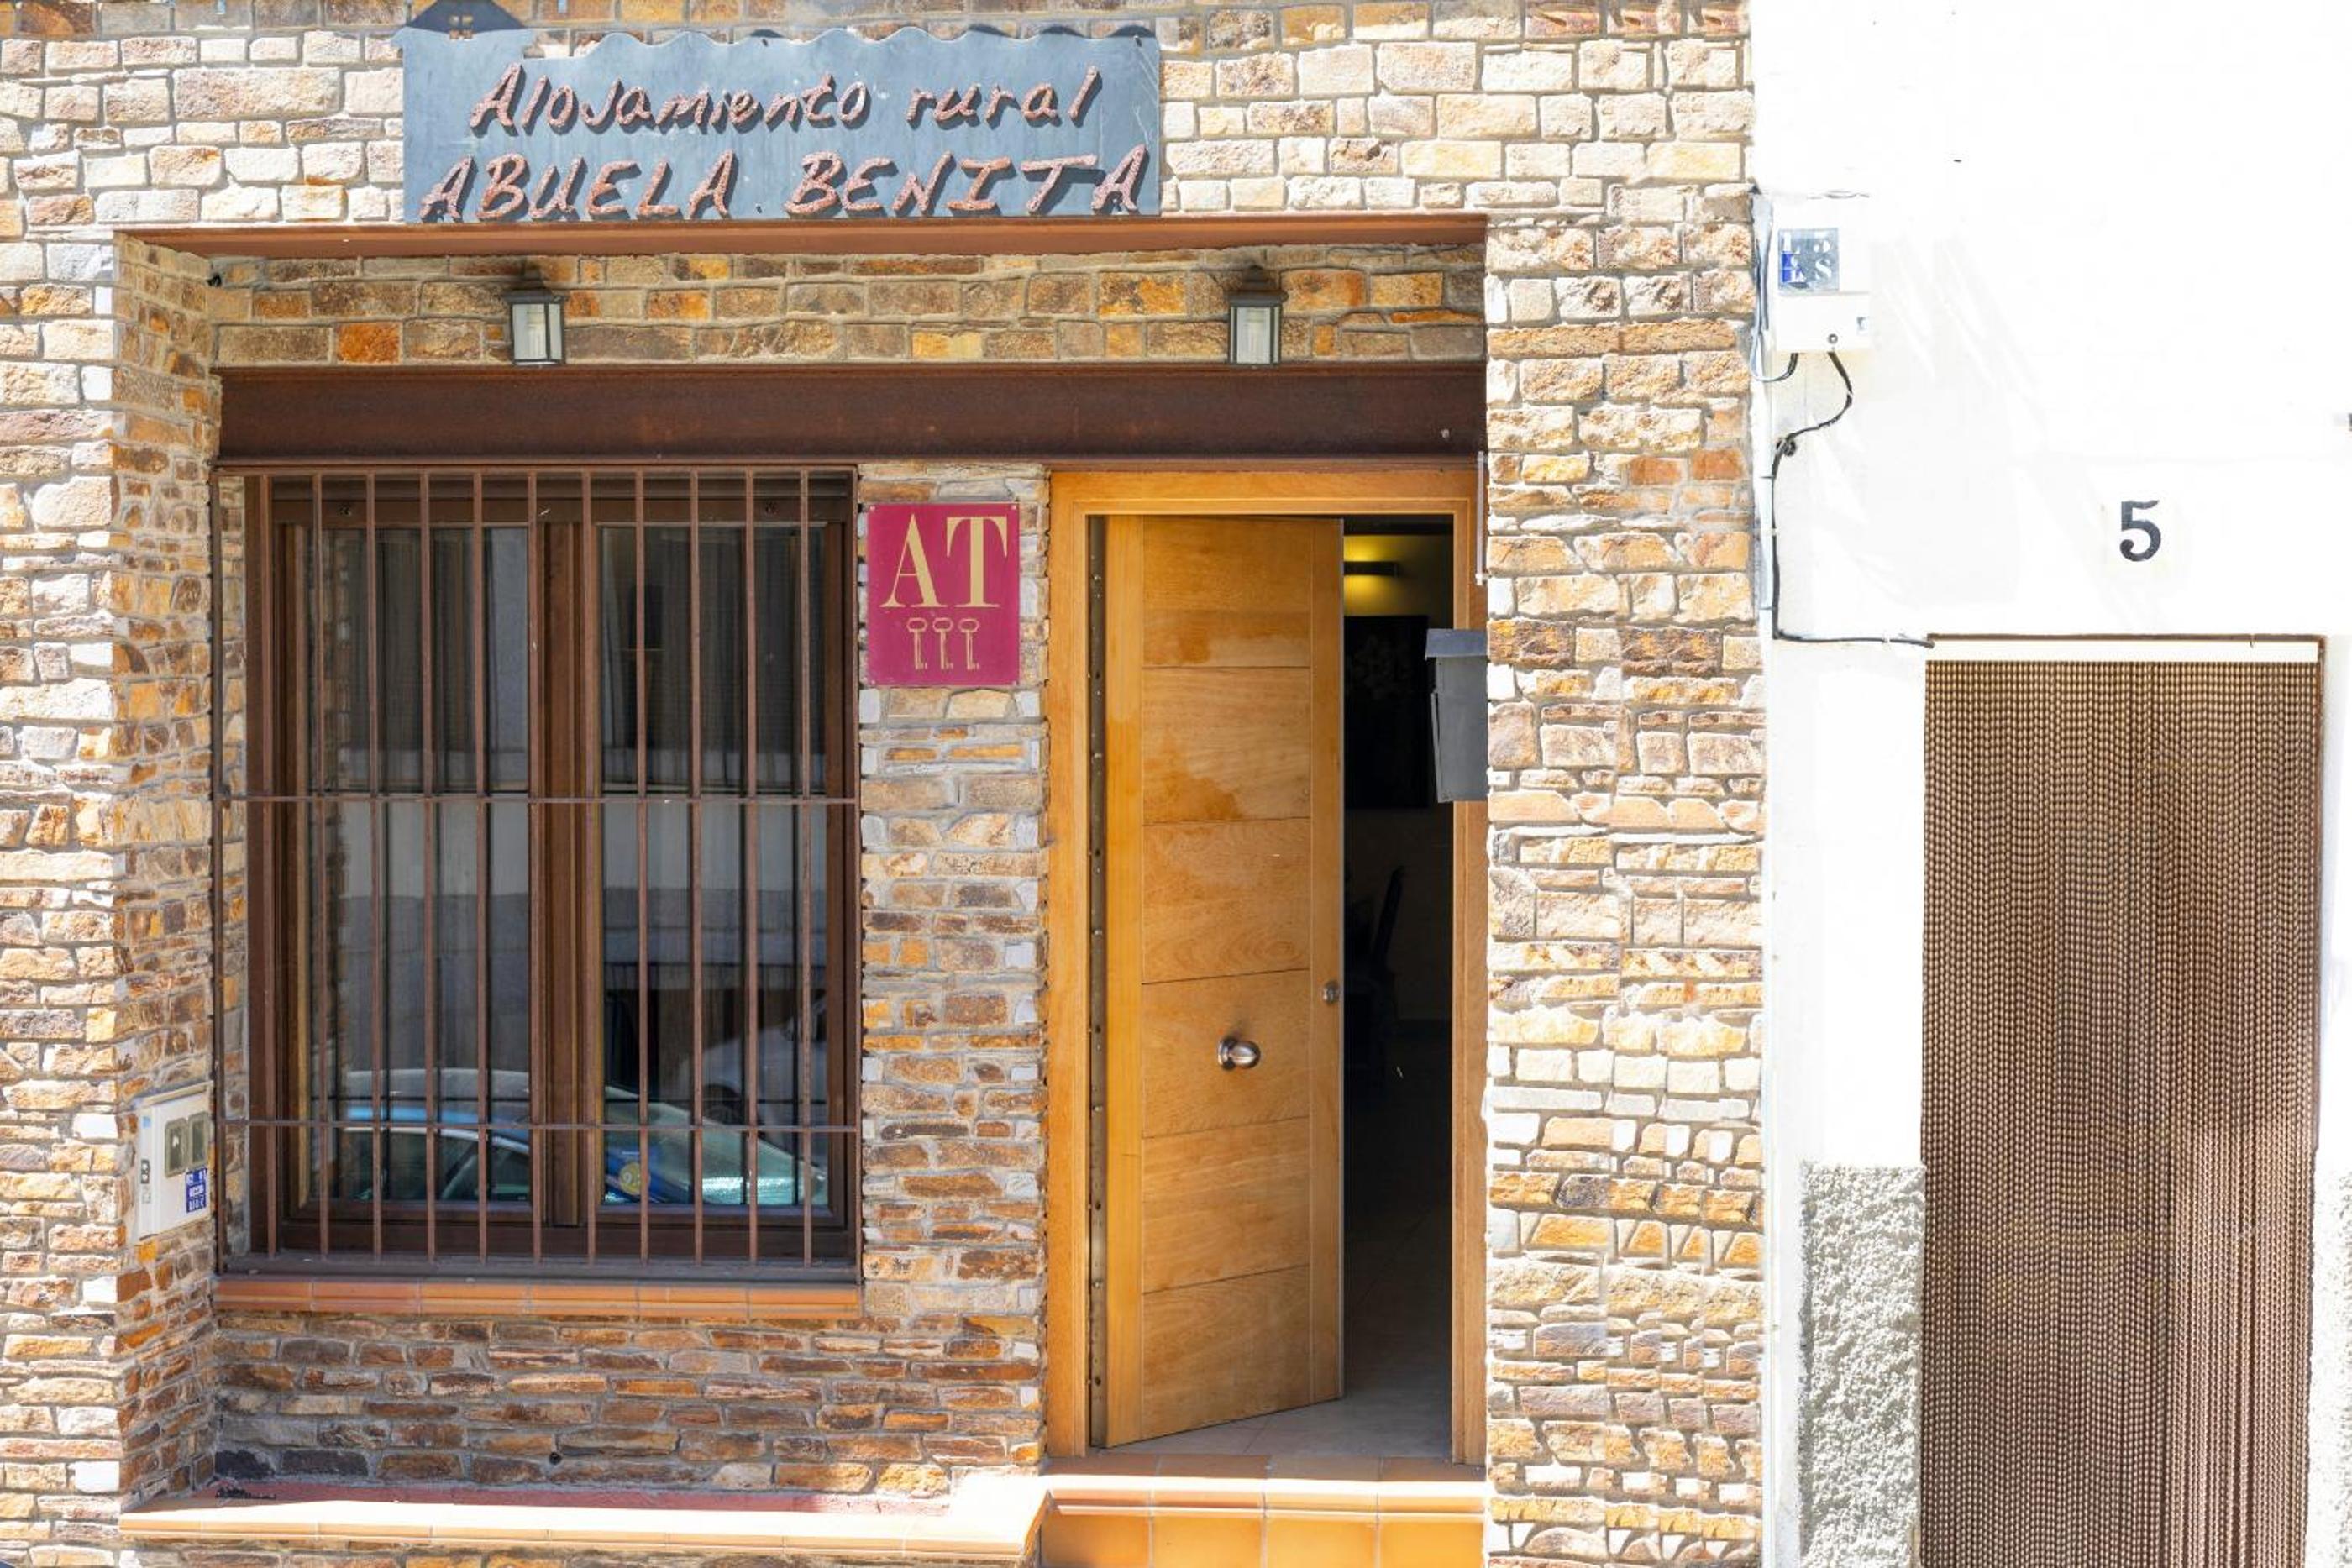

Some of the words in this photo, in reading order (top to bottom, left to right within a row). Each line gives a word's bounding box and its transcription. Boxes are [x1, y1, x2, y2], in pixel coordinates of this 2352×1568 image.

[906, 66, 1098, 123] rural
[419, 149, 737, 219] ABUELA
[785, 144, 1148, 216] BENITA
[879, 513, 1008, 608] AT
[2119, 500, 2161, 562] 5
